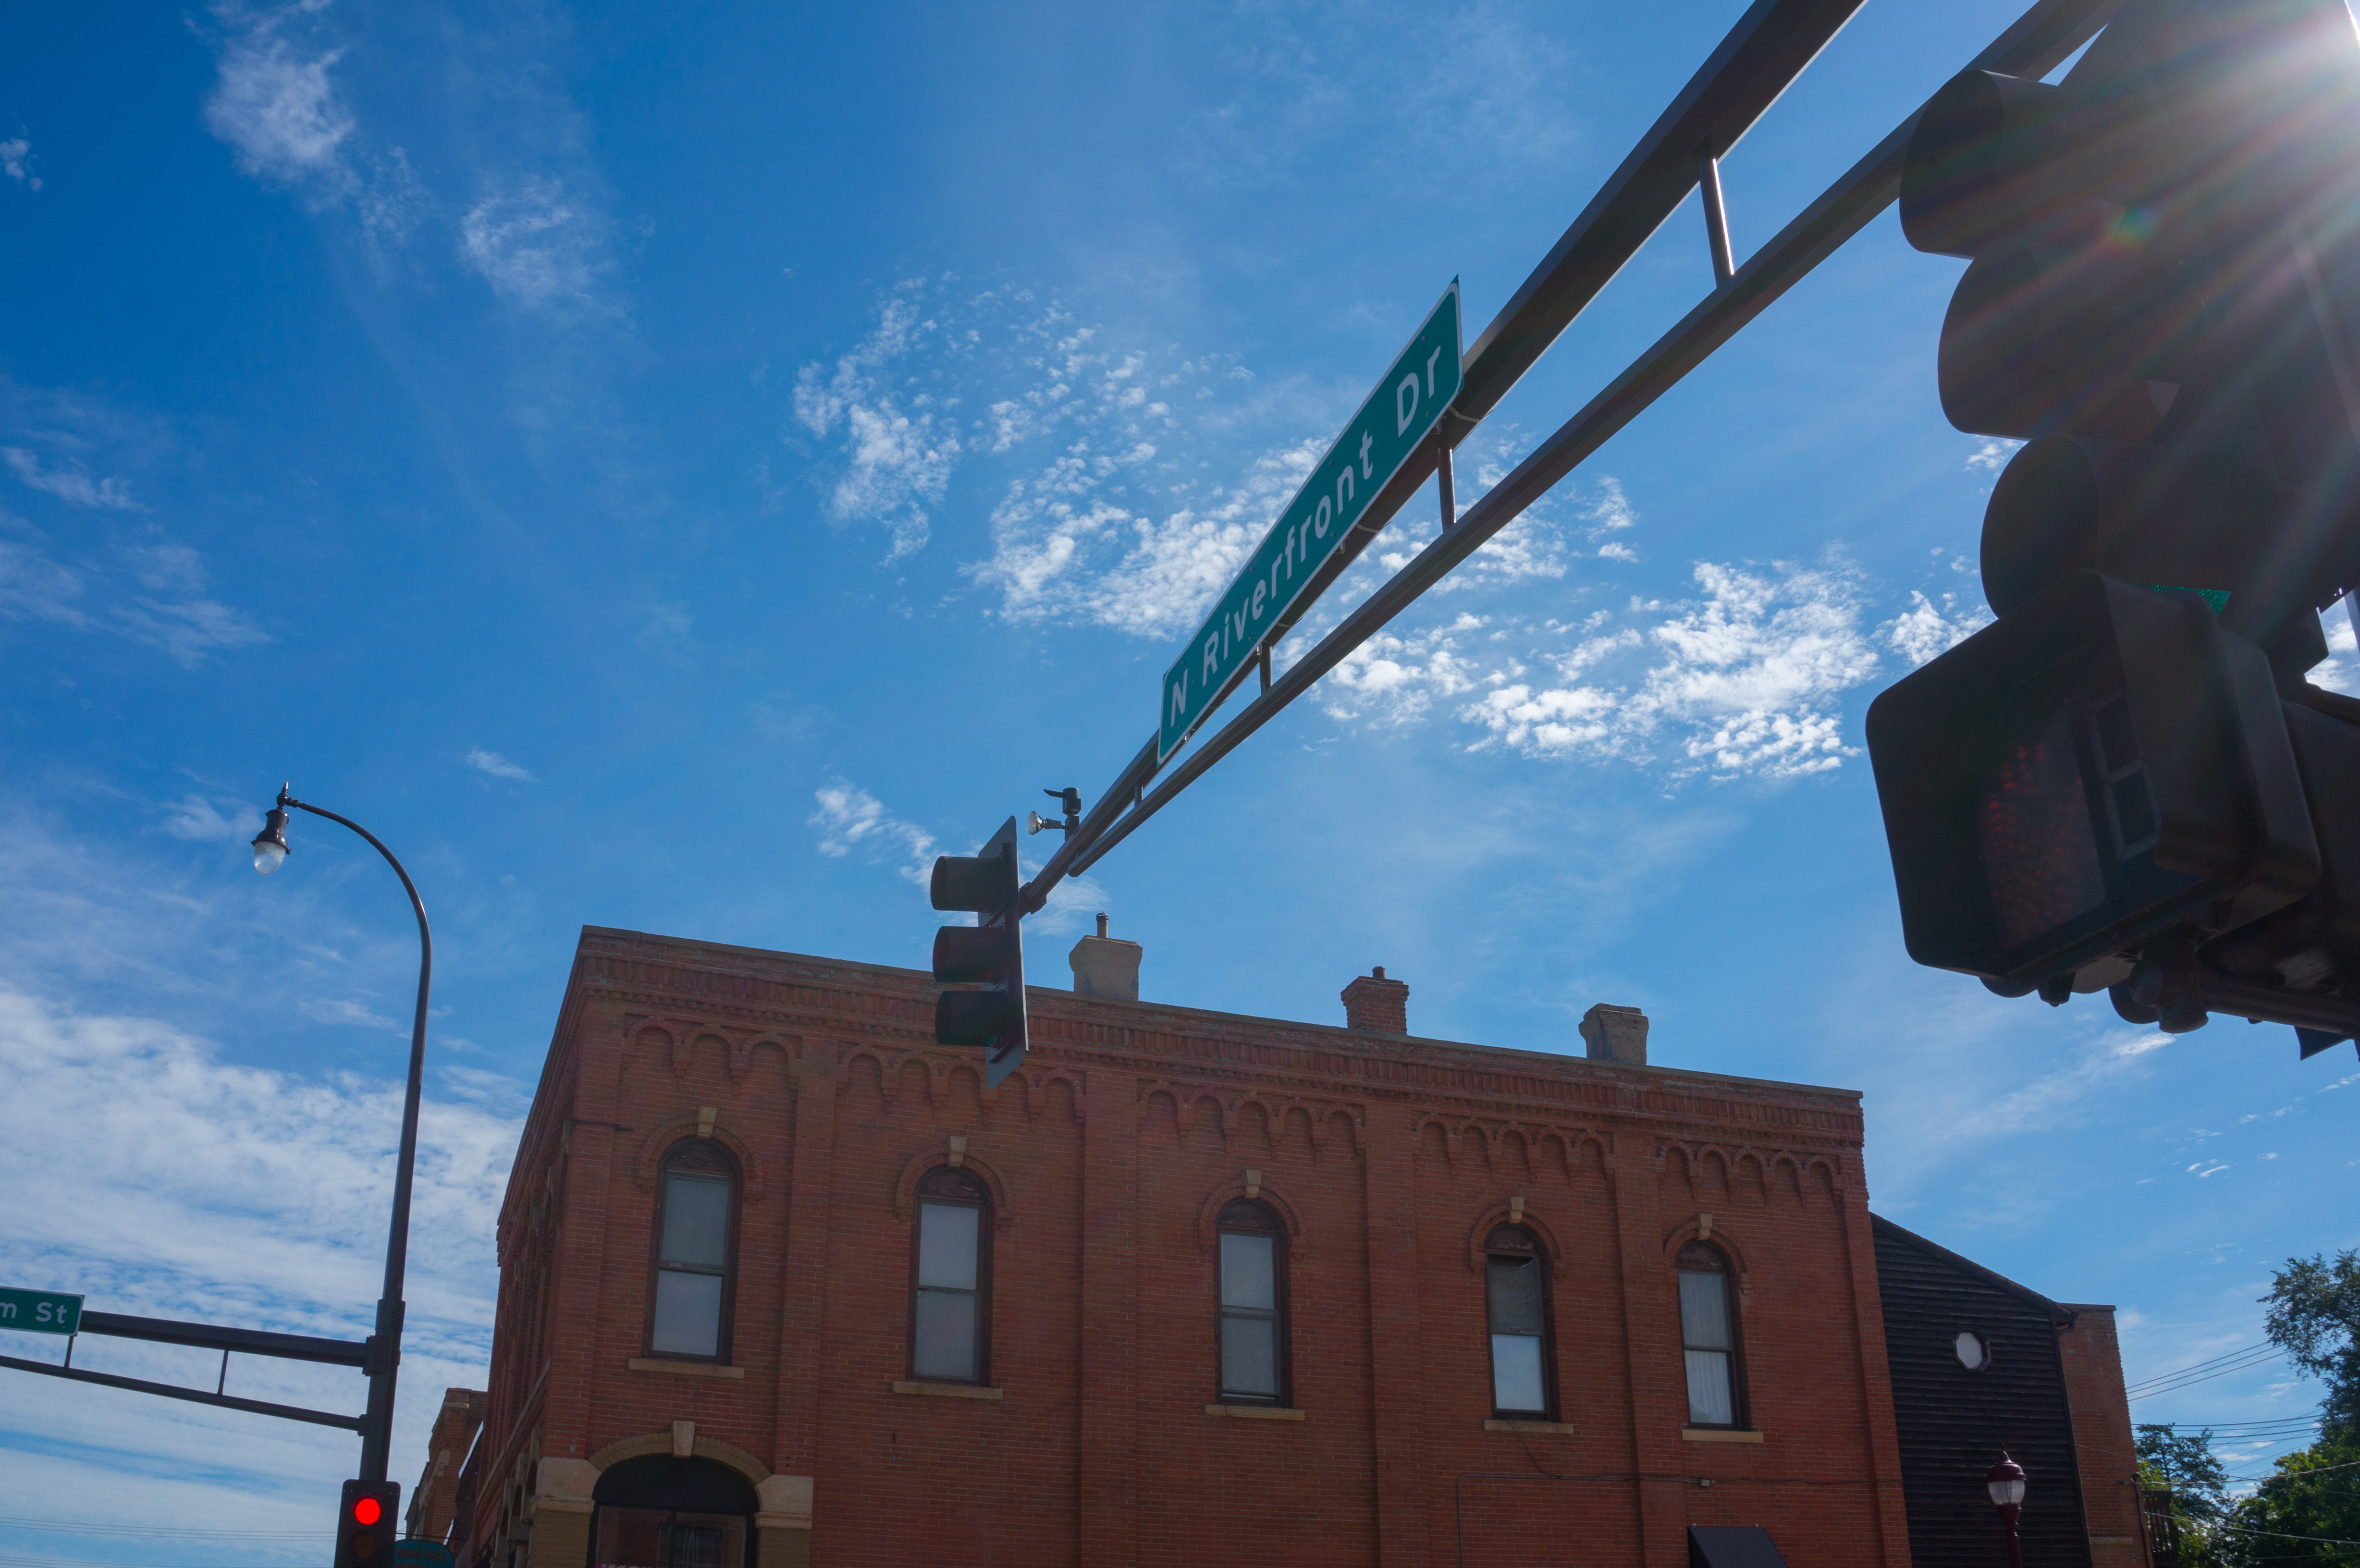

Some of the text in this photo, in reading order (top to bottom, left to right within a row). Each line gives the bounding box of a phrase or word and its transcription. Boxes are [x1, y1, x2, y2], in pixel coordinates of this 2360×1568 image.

[1170, 344, 1441, 728] N Riverfront Dr
[35, 1302, 67, 1323] St
